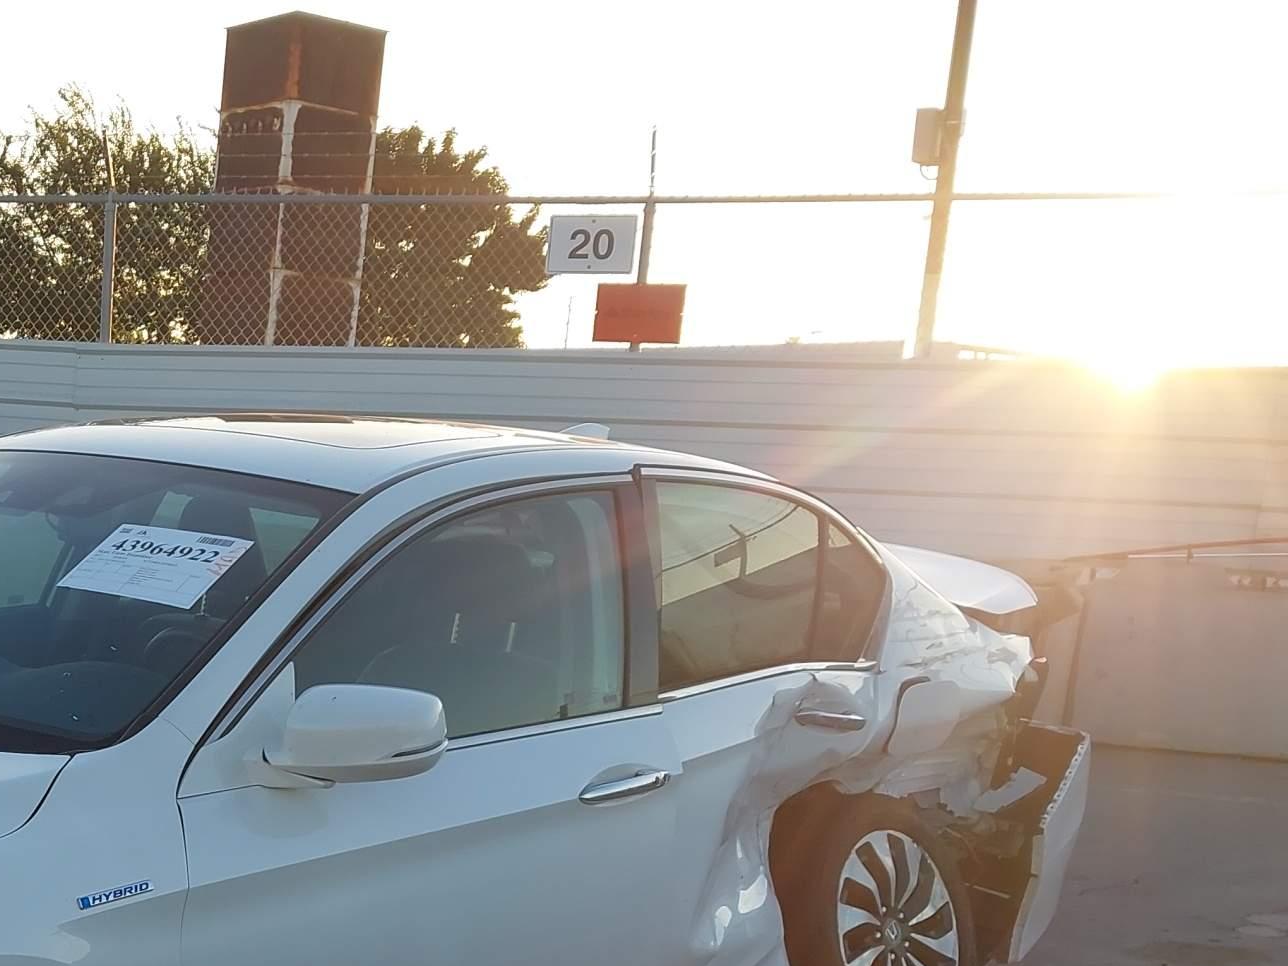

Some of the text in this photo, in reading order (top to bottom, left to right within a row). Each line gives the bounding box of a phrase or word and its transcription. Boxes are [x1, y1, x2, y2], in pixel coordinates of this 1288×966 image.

[567, 228, 615, 260] 20
[111, 538, 220, 564] 43964922
[91, 882, 149, 905] HYBRID
